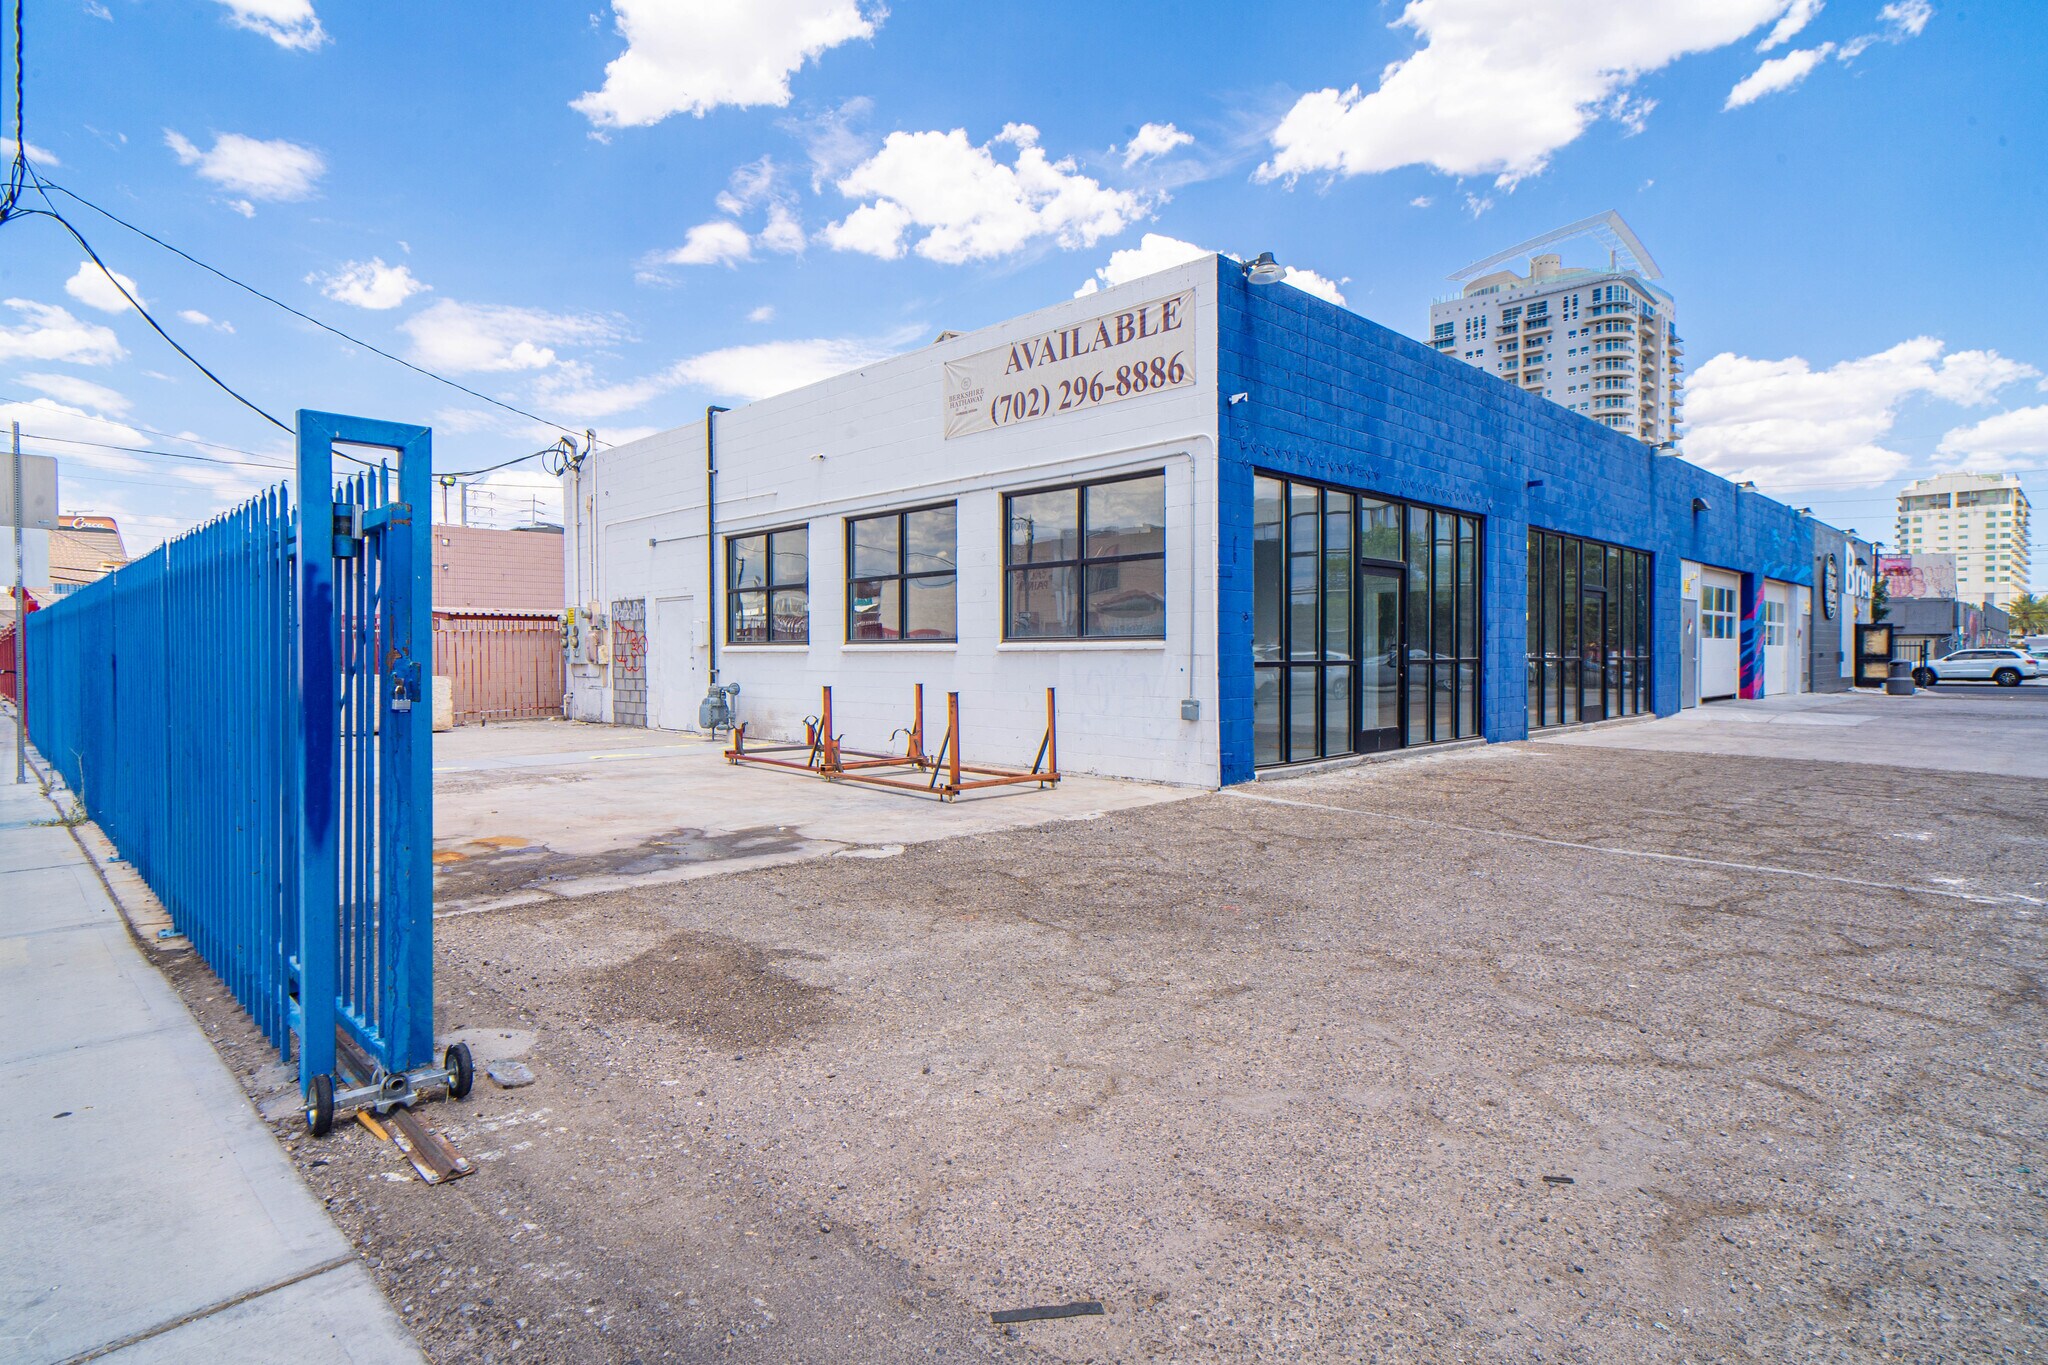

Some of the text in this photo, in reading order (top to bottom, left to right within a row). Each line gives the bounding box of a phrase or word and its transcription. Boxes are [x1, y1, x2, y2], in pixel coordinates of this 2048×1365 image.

[1004, 296, 1183, 376] AVAILABLE
[948, 387, 985, 403] BERKSHIRE
[949, 394, 984, 409] HATHAWAY
[990, 350, 1186, 426] (702) 296-8886
